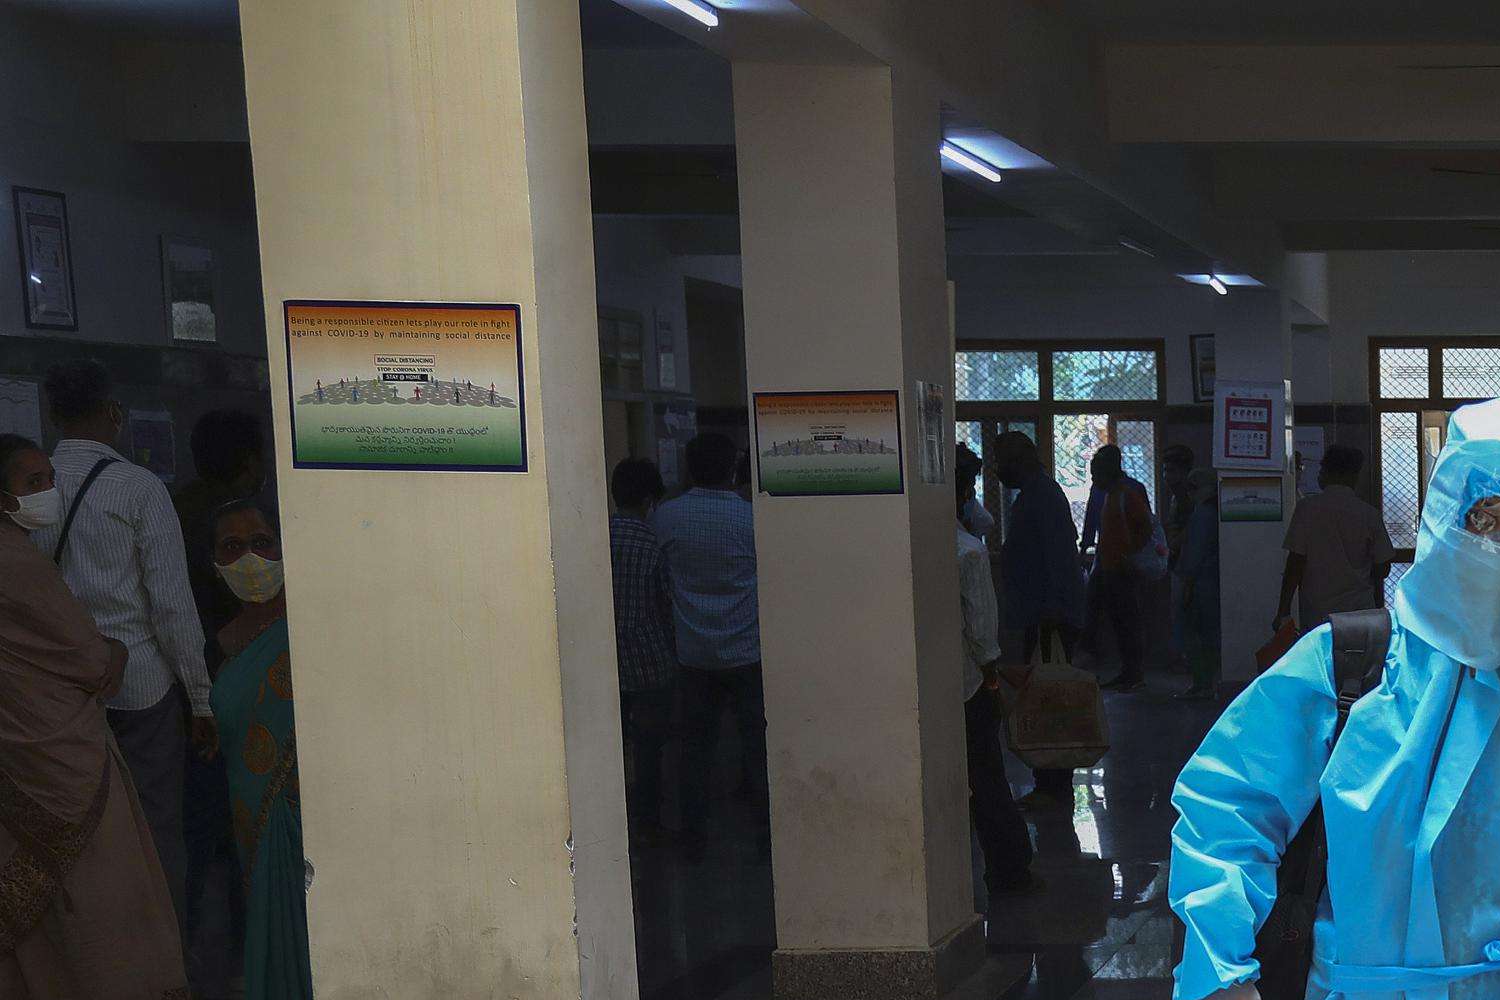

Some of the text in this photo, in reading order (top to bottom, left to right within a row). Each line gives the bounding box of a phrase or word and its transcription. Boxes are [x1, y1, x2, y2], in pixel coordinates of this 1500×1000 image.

[291, 316, 315, 326] Being
[324, 316, 375, 327] responsible
[377, 317, 404, 326] citizen
[406, 318, 423, 326] lets
[424, 319, 441, 328] play
[461, 320, 479, 328] role
[480, 320, 488, 328] in
[491, 320, 511, 329] fight
[291, 329, 511, 340] against COVID-19 by maintaining social distance
[412, 427, 446, 435] COVID-19
